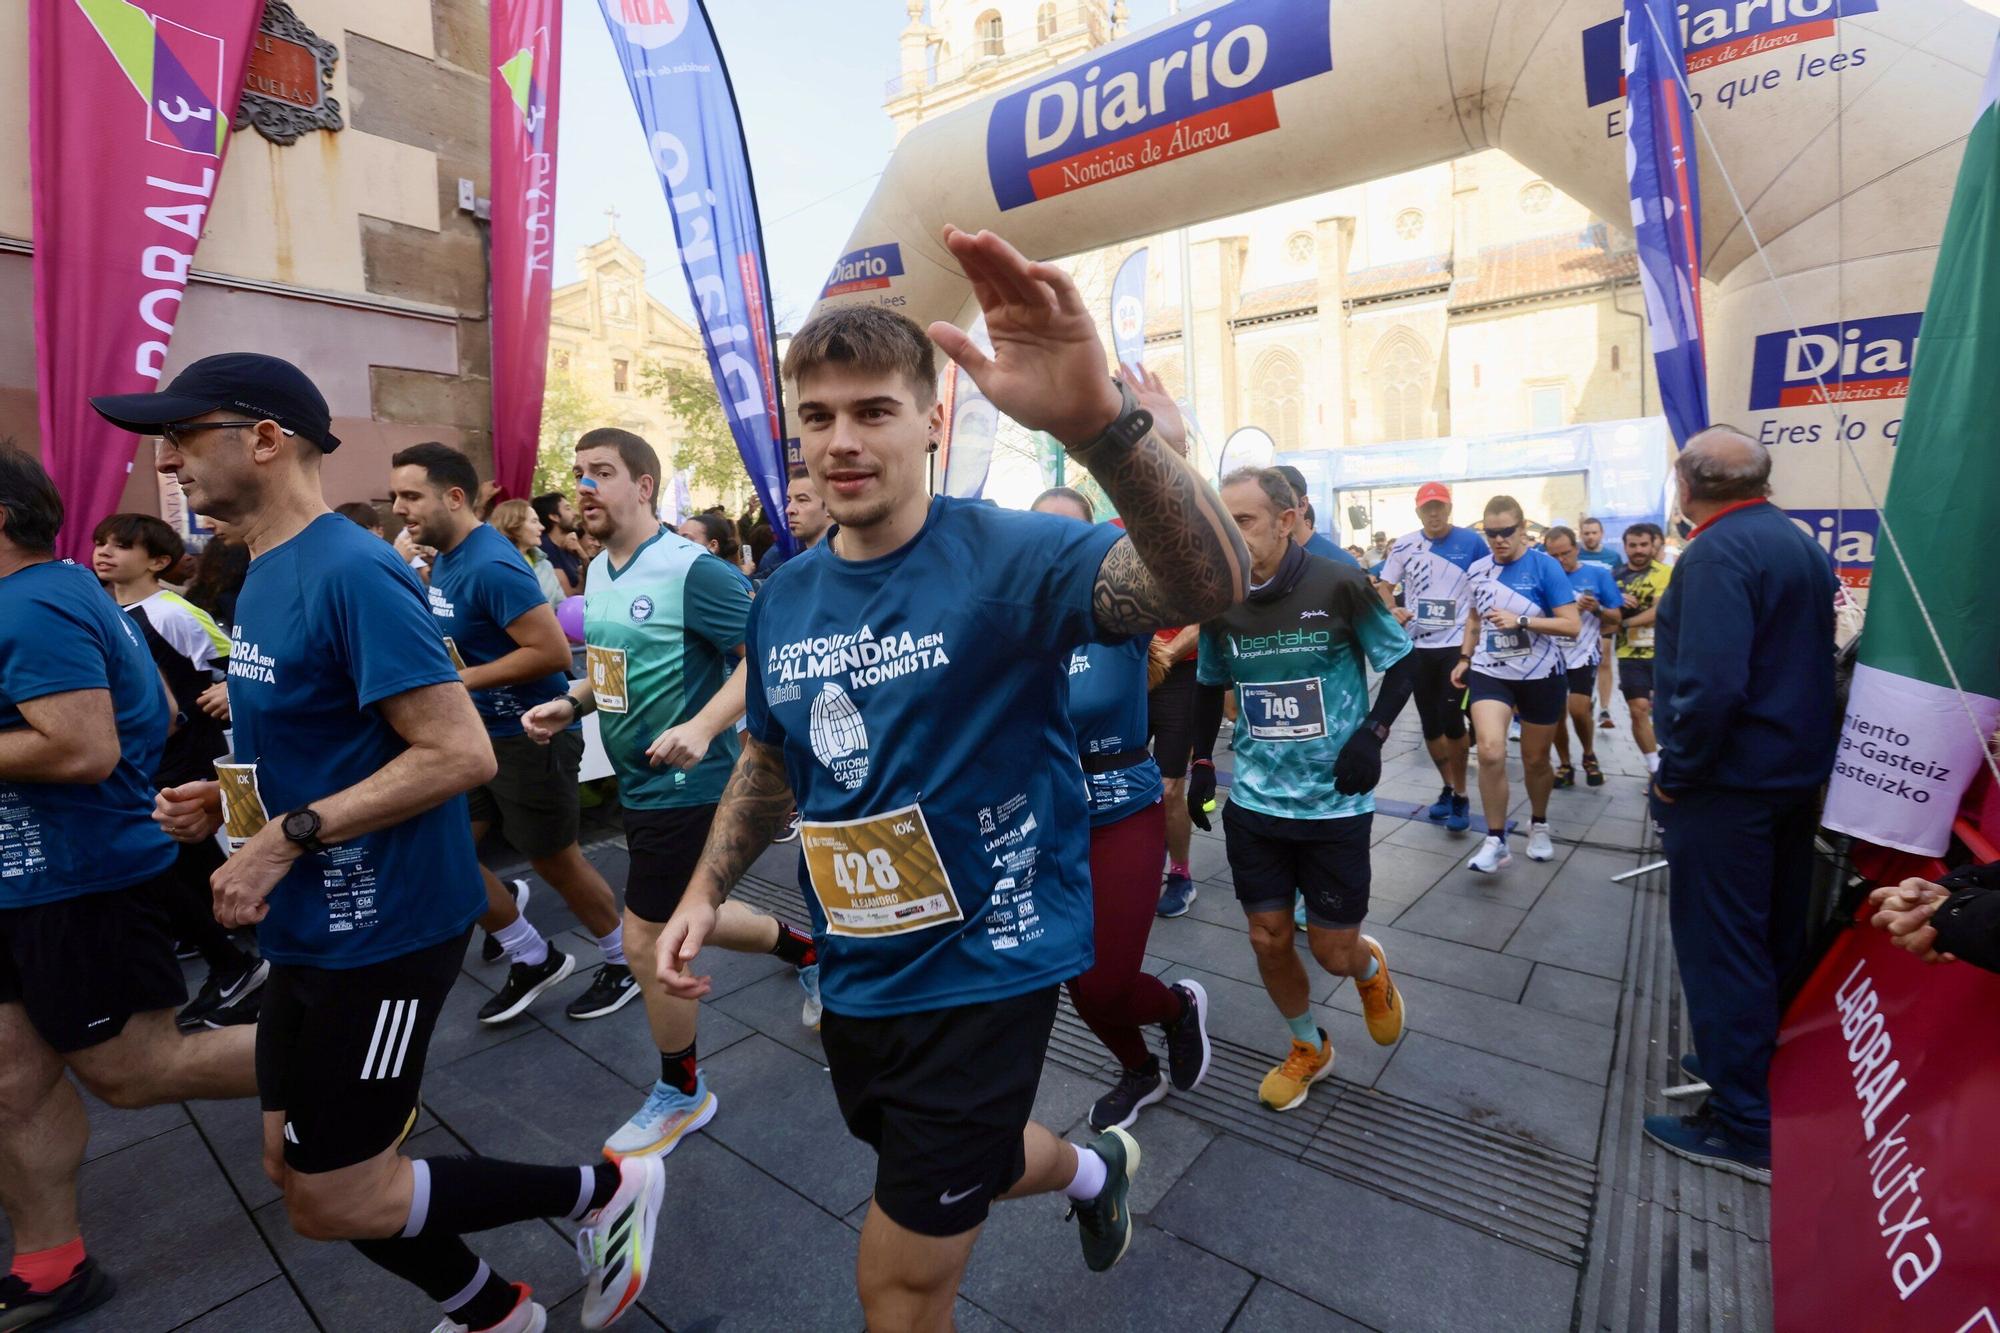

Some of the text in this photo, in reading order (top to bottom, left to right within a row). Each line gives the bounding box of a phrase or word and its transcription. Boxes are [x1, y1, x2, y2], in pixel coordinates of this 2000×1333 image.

[1717, 41, 1738, 62] de
[1741, 33, 1799, 55] Álava
[1025, 20, 1268, 159] Diario
[1717, 69, 1780, 109] que
[1796, 47, 1867, 81] lees
[1062, 120, 1231, 188] Noticias de Álava
[828, 251, 887, 286] Diario
[1808, 384, 1883, 403] Noticias
[1759, 420, 1822, 445] Eres
[1836, 414, 1866, 441] lo
[1426, 605, 1446, 617] 742
[780, 624, 875, 661] CONQUISTA
[1240, 628, 1330, 650] bertako
[259, 656, 275, 668] REN
[780, 630, 944, 684] ALMENDRA REN
[850, 647, 950, 690] KONKISTA
[1261, 697, 1299, 719] 746
[831, 756, 869, 772] VITORIA
[1841, 732, 1951, 782] a-Gasteiz
[1835, 755, 1930, 803] asteizko
[893, 820, 915, 837] 10K
[984, 827, 1020, 853] LABORAL
[833, 848, 901, 895] 428
[851, 893, 899, 909] ALEJANDRO
[1834, 958, 1908, 1142] LABORAL
